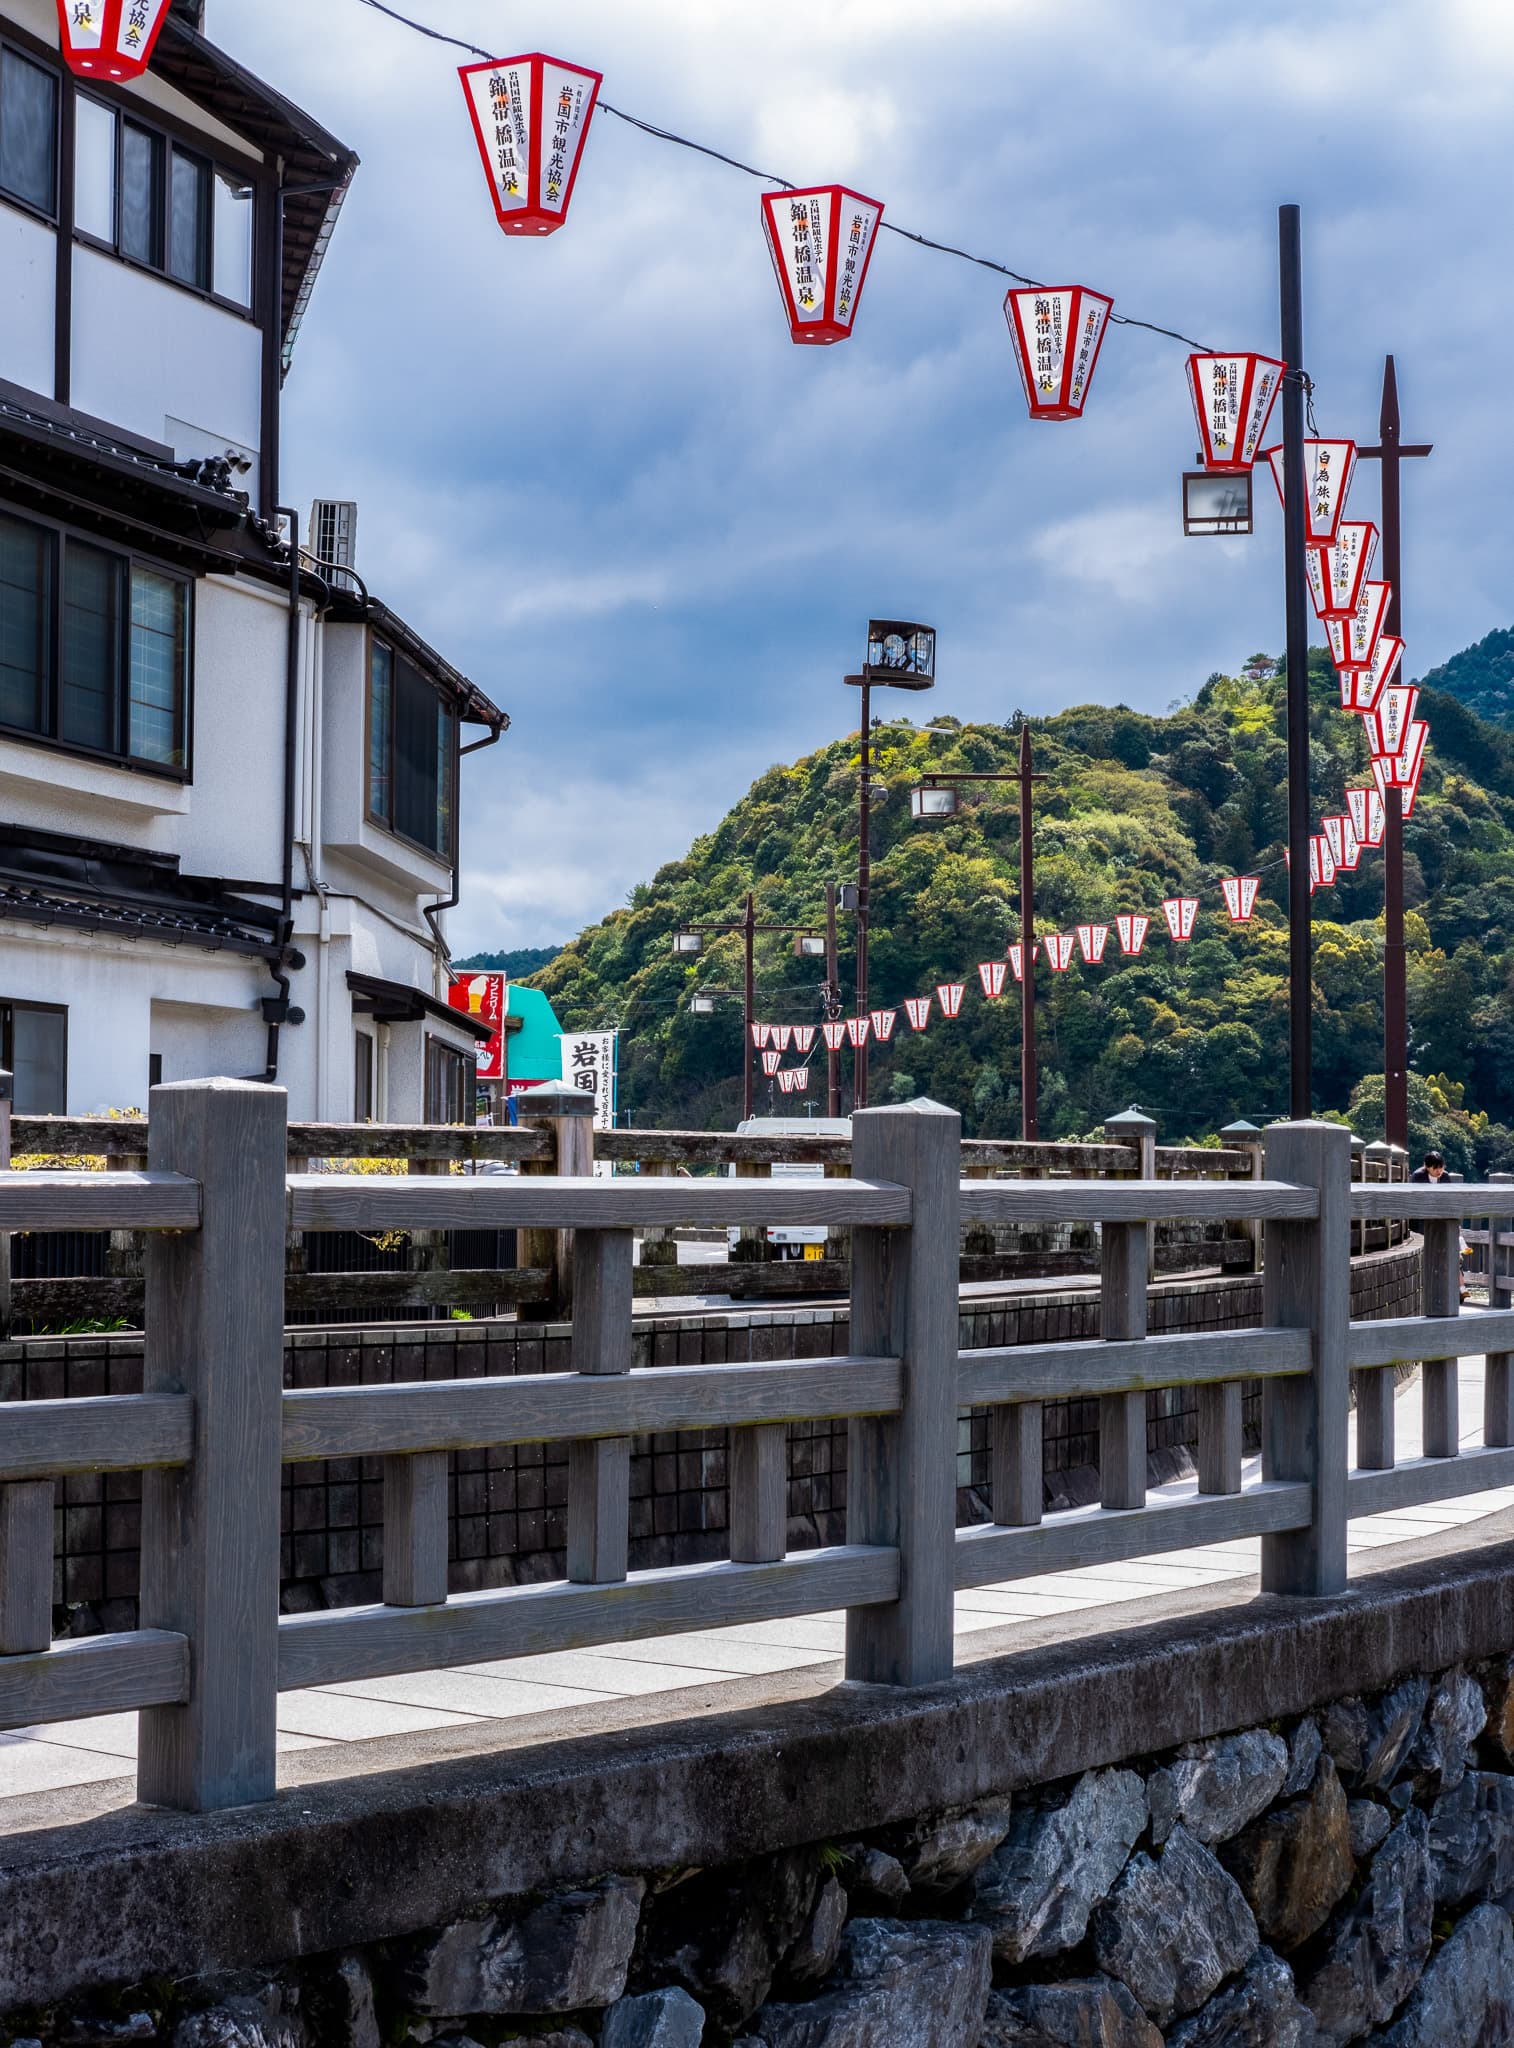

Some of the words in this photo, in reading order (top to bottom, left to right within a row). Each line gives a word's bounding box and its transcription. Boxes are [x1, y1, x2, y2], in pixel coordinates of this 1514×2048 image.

[488, 76, 519, 192] 錦帯橋温泉
[508, 71, 526, 145] 岩国国際観光ホテル
[545, 86, 574, 203] 岩国市観光協会
[790, 203, 815, 304] 錦帯橋温泉
[810, 199, 824, 265] 岩国国際観光ホテル
[838, 214, 863, 317] 岩国市観光協会
[1034, 299, 1053, 390] 錦帯橋温泉
[1072, 309, 1097, 401] 岩国市観光協会
[1212, 364, 1228, 446] 錦帯橋温泉
[1314, 450, 1331, 517] 白為旅館
[1340, 534, 1349, 588] しらため別館
[571, 1041, 600, 1115] 岩国
